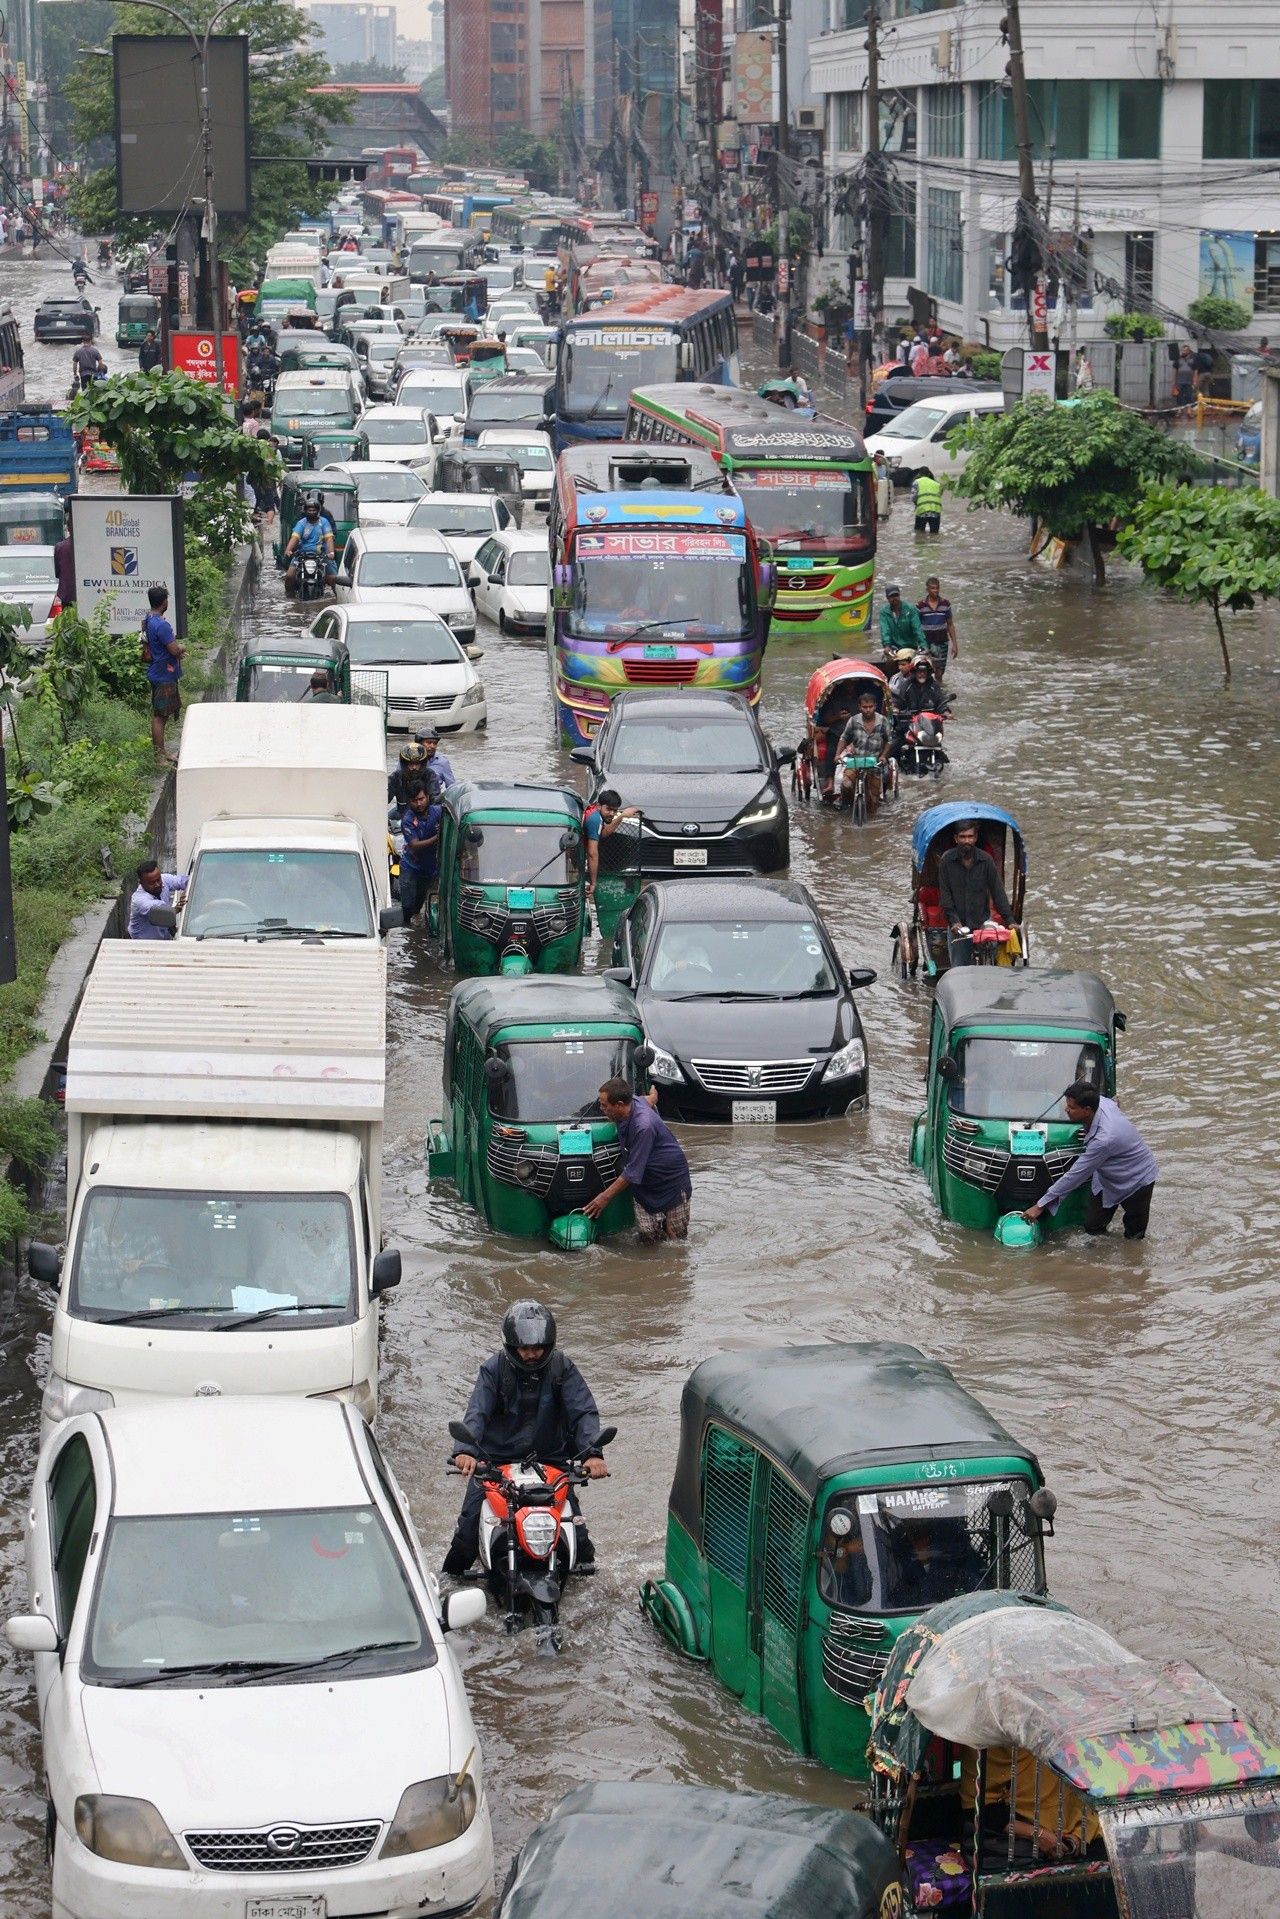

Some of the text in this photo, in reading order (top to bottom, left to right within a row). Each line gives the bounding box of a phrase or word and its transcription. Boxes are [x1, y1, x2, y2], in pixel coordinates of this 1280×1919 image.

[106, 527, 141, 537] BRANCHES
[607, 533, 678, 551] সাভার
[680, 537, 711, 548] পরিবহন
[103, 579, 130, 588] VILLA
[132, 579, 168, 588] MEDICA
[1020, 1170, 1032, 1178] RE
[912, 1503, 945, 1511] BATTERY
[251, 1907, 274, 1917] ঢাকা
